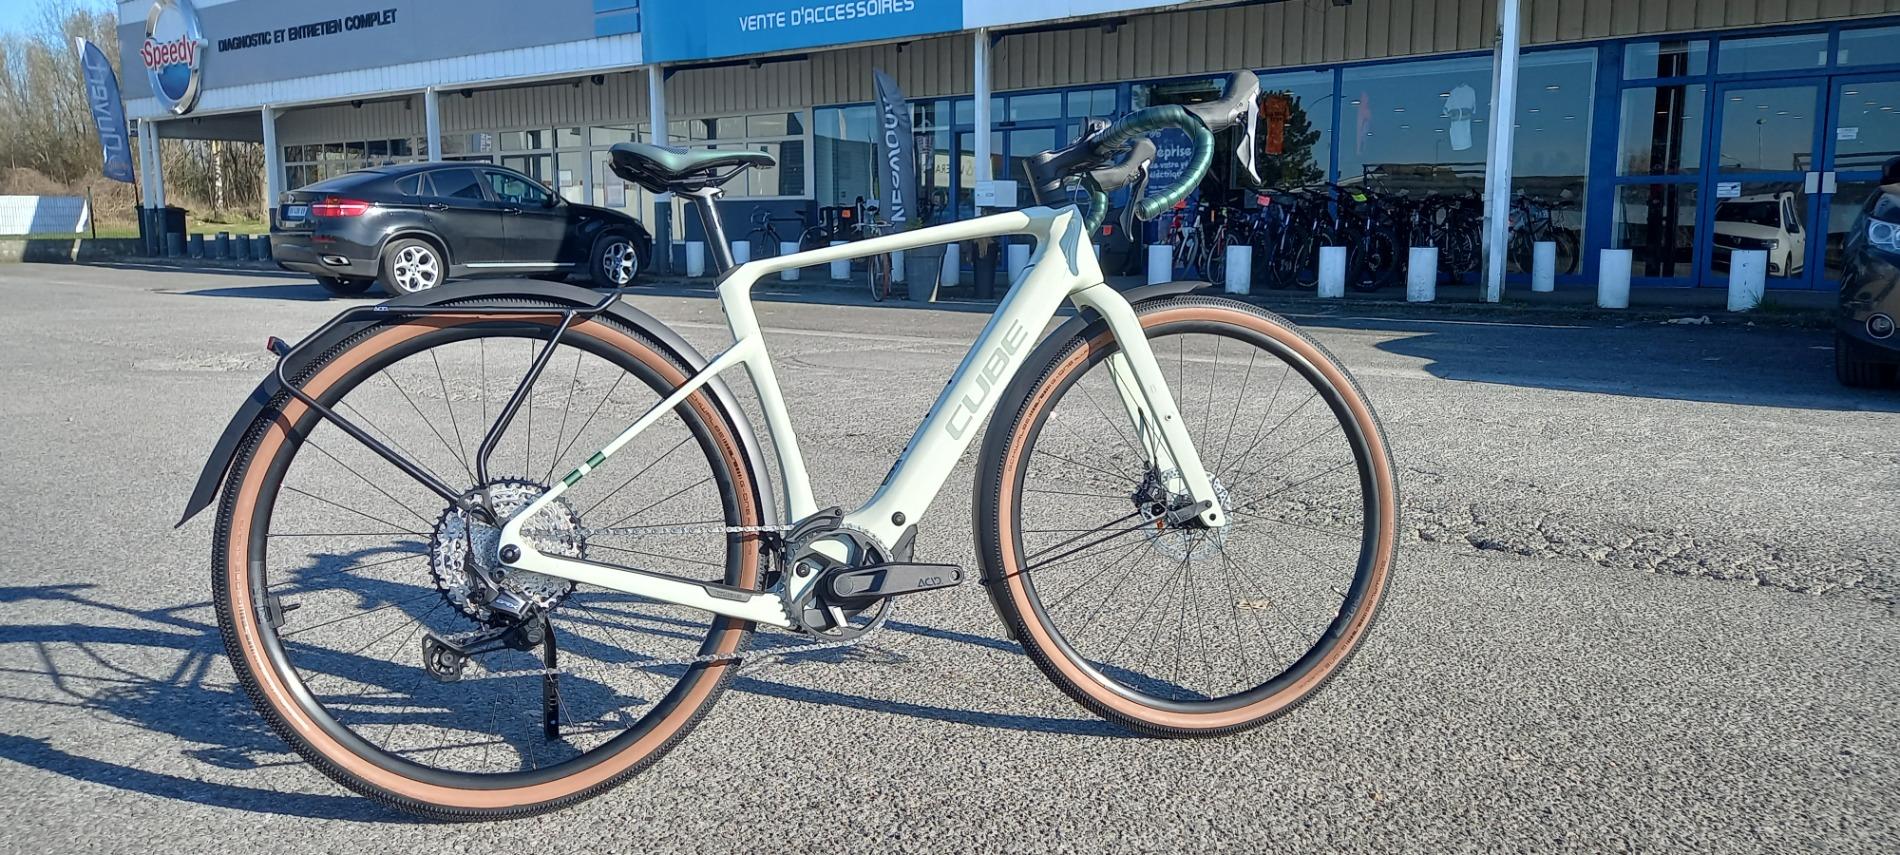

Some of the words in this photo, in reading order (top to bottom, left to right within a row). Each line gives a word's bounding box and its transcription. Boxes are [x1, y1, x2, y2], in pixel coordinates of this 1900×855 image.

[218, 31, 271, 52] DIAGNOSTIC
[274, 29, 286, 43] ET
[288, 19, 342, 40] ENTRETIEN
[344, 8, 397, 31] COMPLET
[739, 12, 786, 31] VENTE
[791, 0, 915, 25] D'ACCESSOIRES
[141, 35, 198, 70] Speedy
[945, 319, 1028, 440] CUBE
[918, 576, 942, 588] ACID
